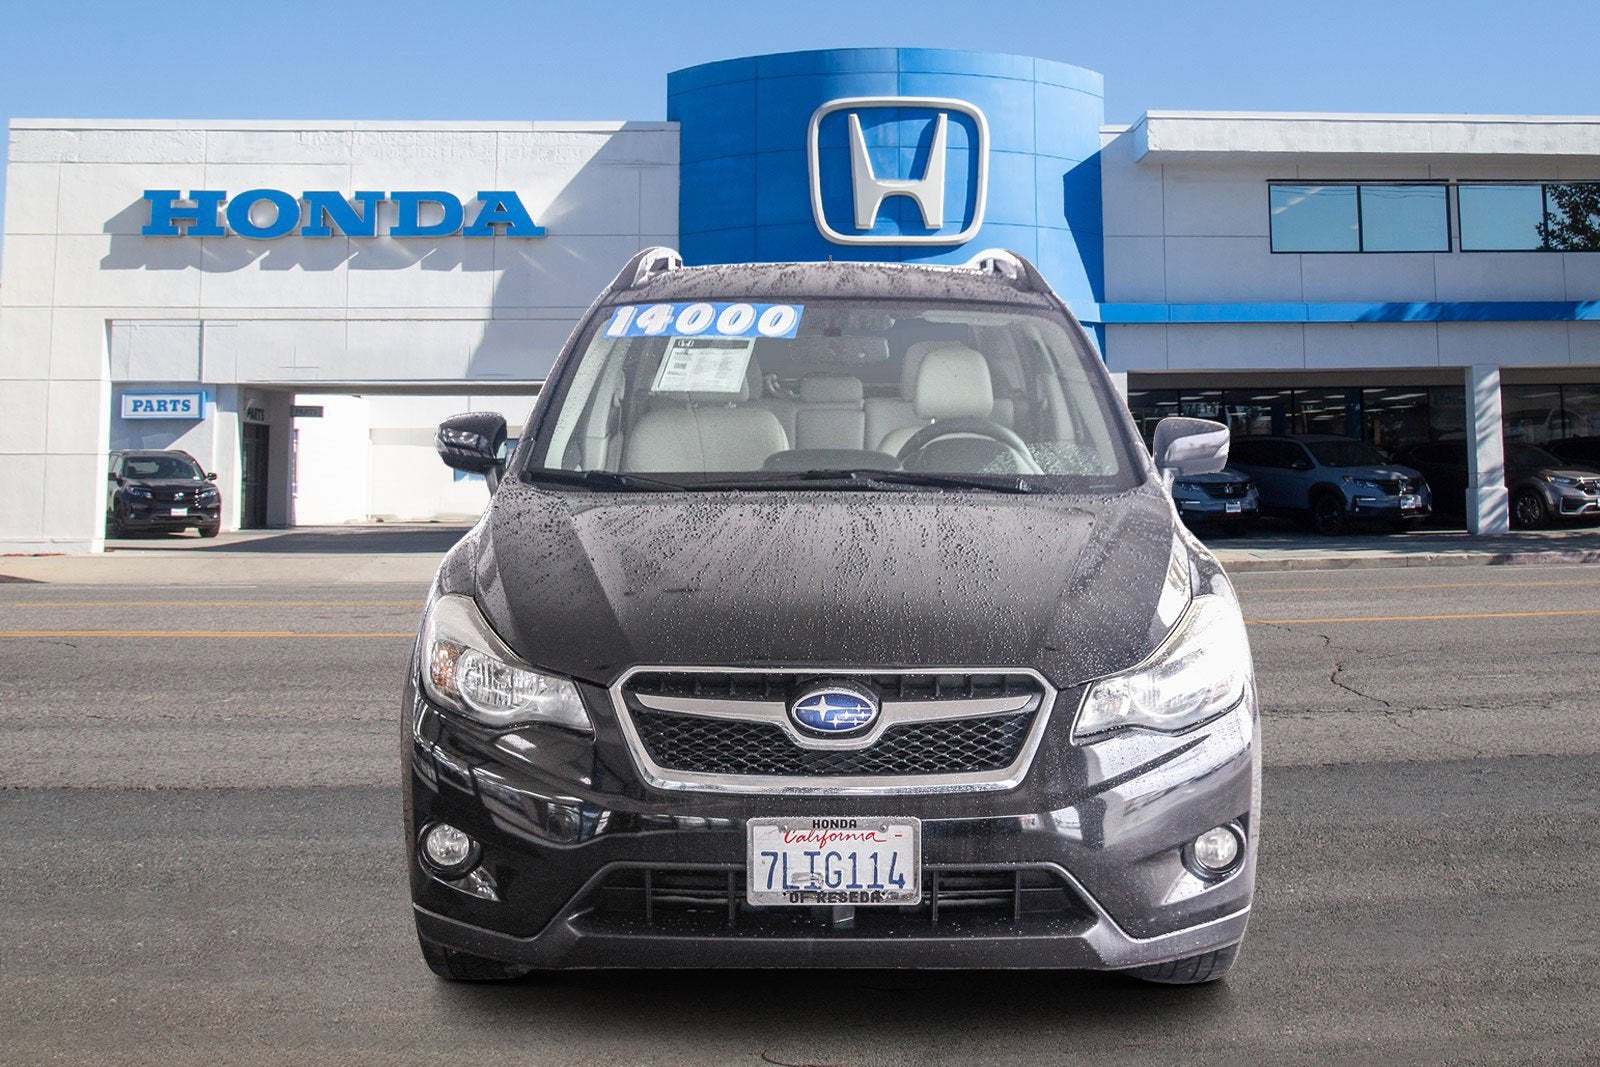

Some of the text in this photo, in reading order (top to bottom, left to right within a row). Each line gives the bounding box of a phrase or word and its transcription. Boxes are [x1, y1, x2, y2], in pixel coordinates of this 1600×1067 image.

[141, 189, 547, 240] HONDA
[606, 303, 798, 336] 14000
[132, 399, 191, 412] PARTS
[812, 819, 857, 829] HONDA
[784, 829, 887, 849] California
[760, 851, 906, 890] 7LIG114
[789, 890, 881, 904] OF RESEDA
